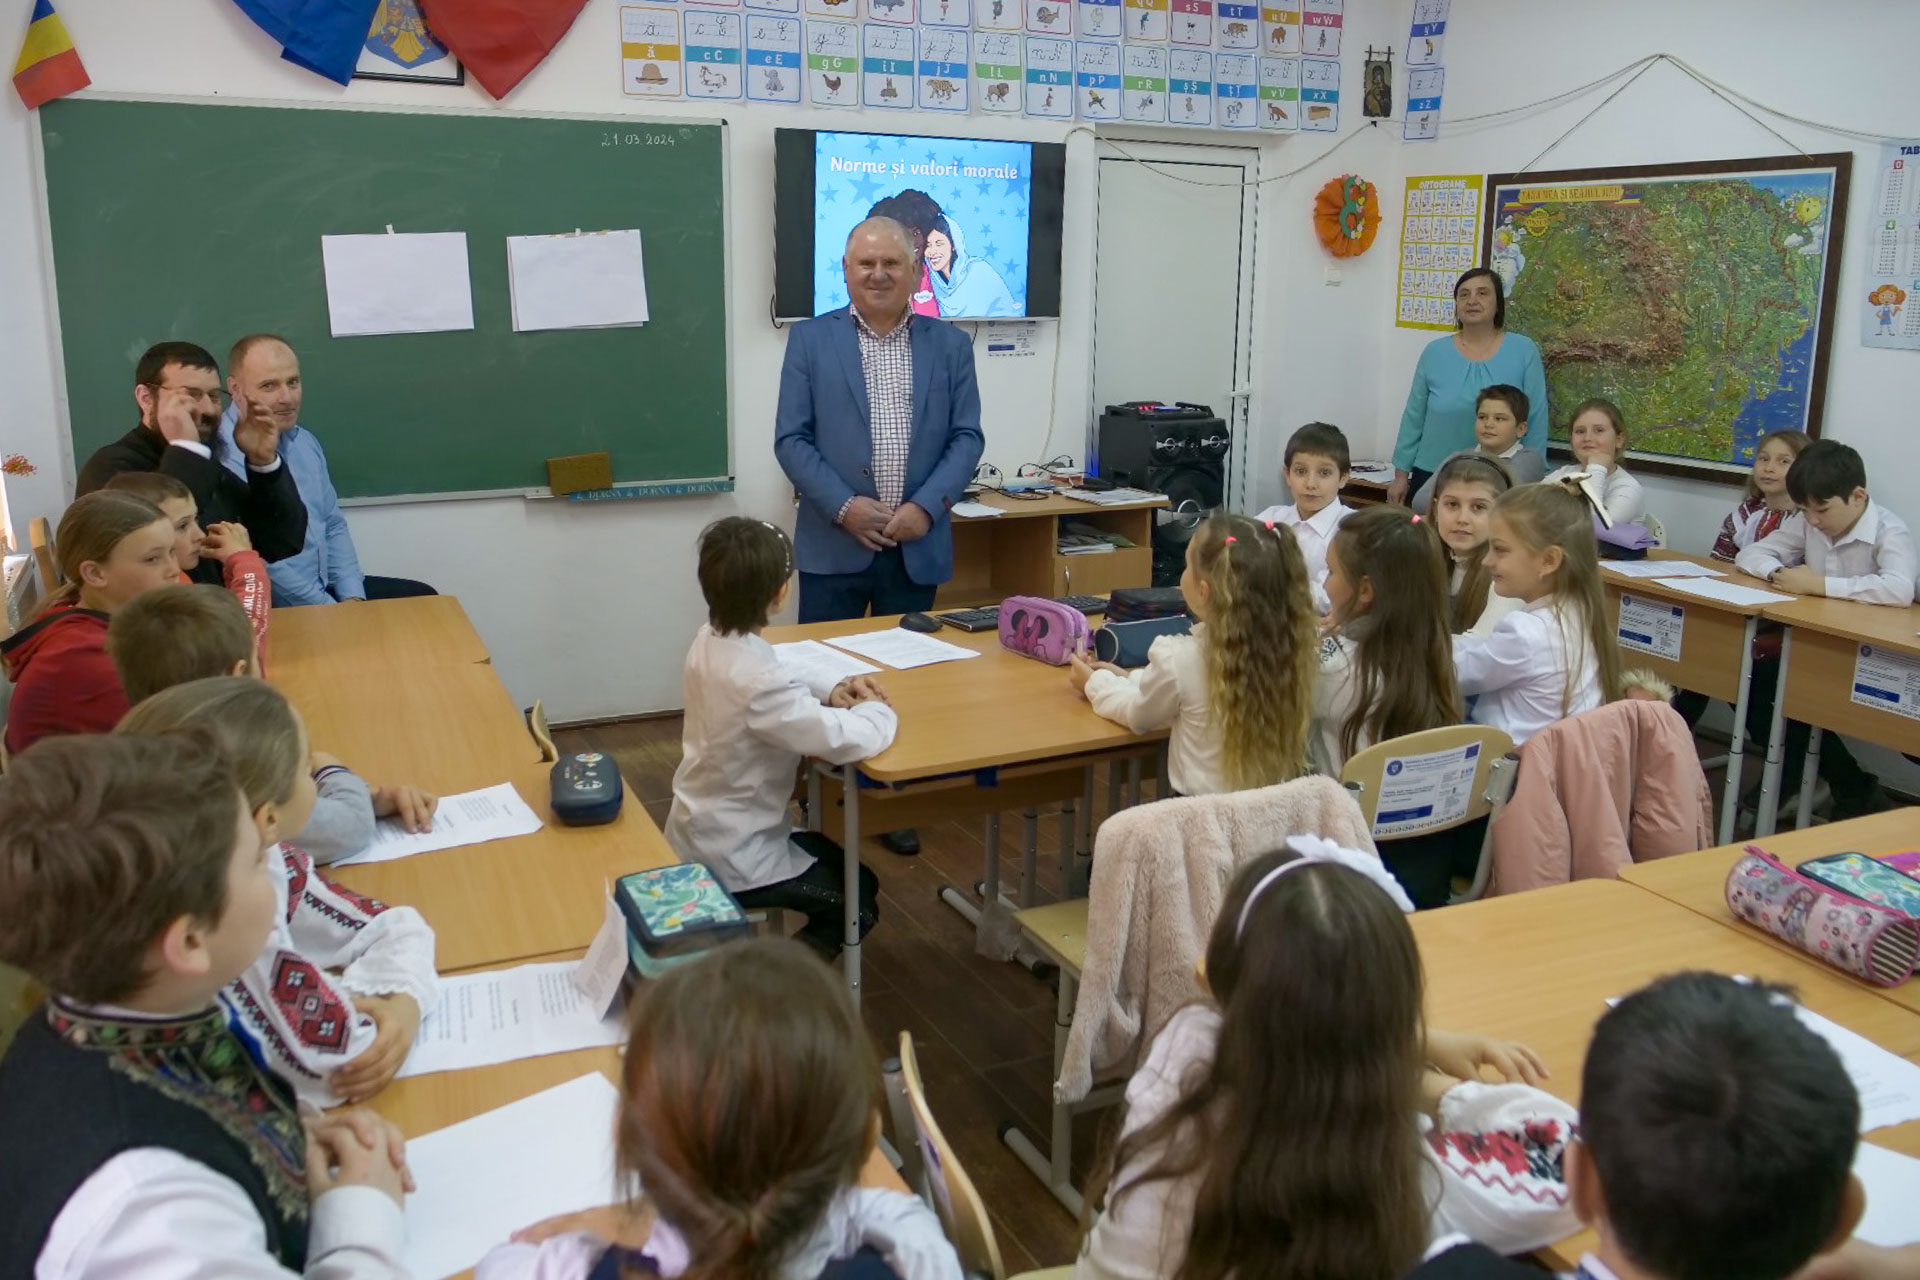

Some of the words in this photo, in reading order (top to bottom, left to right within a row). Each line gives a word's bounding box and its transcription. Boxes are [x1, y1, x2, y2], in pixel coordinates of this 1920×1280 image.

[704, 52, 710, 60] c
[714, 50, 722, 60] C
[765, 55, 772, 64] e
[776, 54, 782, 65] E
[822, 59, 829, 70] g
[832, 58, 842, 68] G
[936, 62, 940, 76] j
[944, 64, 951, 74] J
[1040, 74, 1046, 82] n
[1050, 73, 1057, 83] N
[1090, 78, 1095, 87] p
[1098, 76, 1104, 85] P
[1138, 80, 1143, 88] r
[1146, 80, 1152, 89] R
[1271, 90, 1276, 98] v
[1280, 89, 1286, 98] V
[1321, 91, 1326, 99] X
[830, 156, 886, 174] Norme
[891, 158, 905, 180] și
[910, 160, 958, 177] valori
[964, 163, 1018, 180] morale
